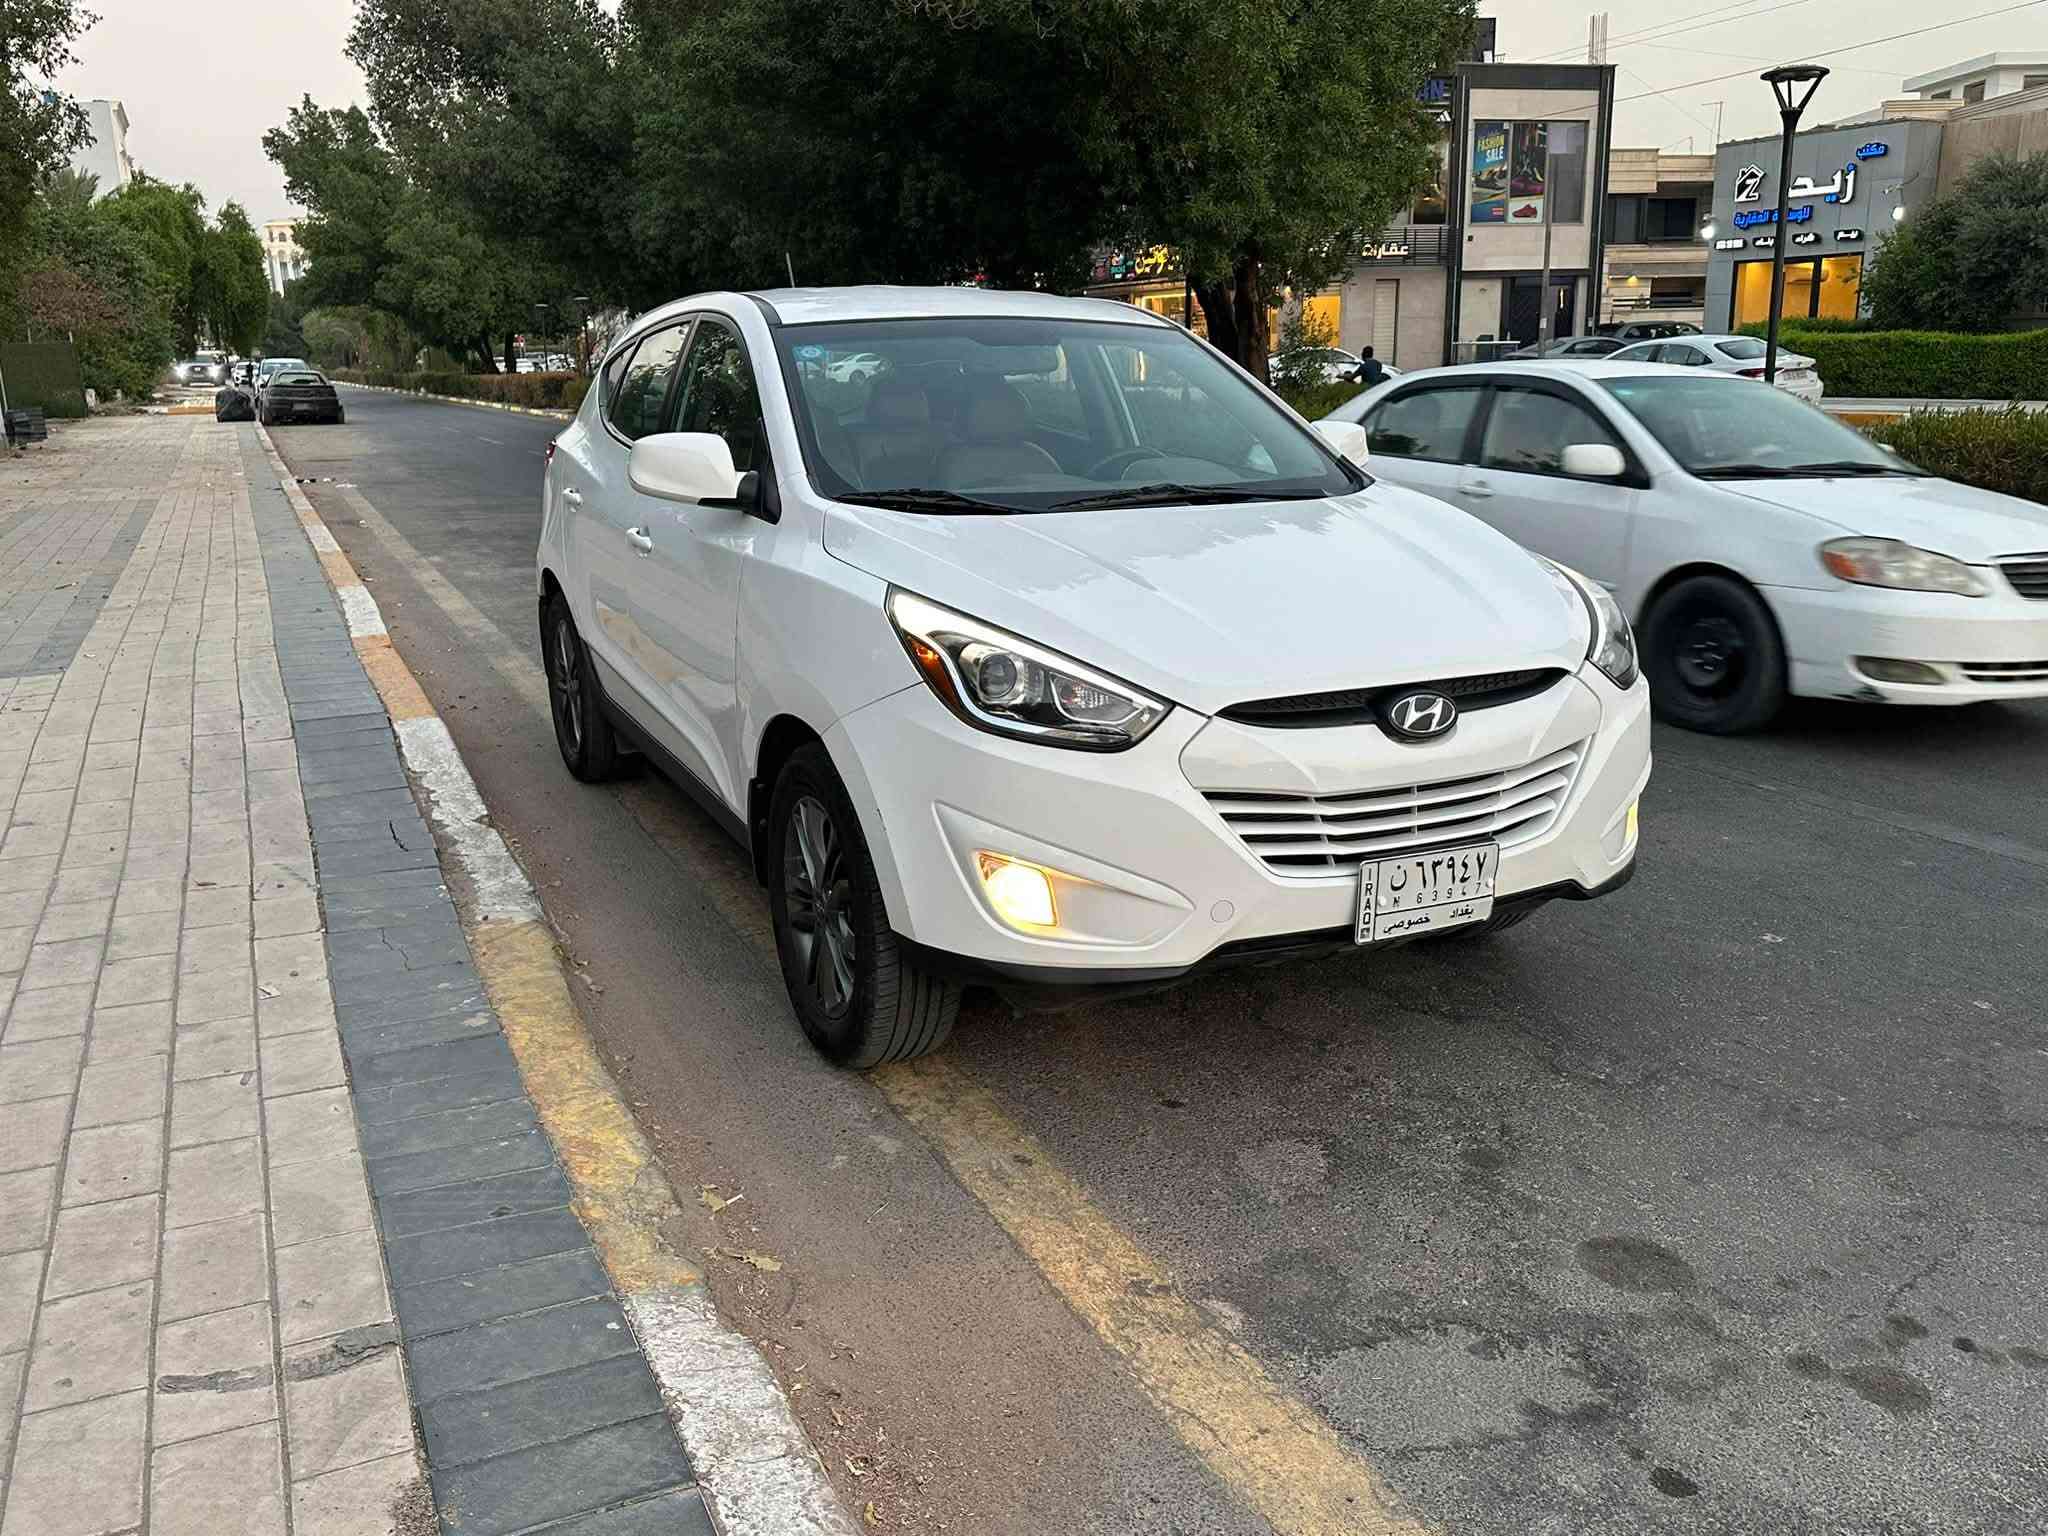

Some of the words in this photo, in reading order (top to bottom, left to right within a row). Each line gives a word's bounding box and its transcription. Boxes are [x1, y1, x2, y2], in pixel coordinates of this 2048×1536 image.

[1486, 147, 1504, 162] SALE
[1857, 144, 1887, 160] مكتب
[1788, 163, 1857, 204] زيد
[1390, 864, 1407, 891] ن
[1416, 852, 1487, 889] ٦٣٩٤٧
[1362, 868, 1373, 925] IRAQ
[1392, 896, 1400, 908] N
[1416, 882, 1481, 904] 63947
[1383, 913, 1431, 934] خصوصي
[1449, 904, 1474, 920] بغداد
